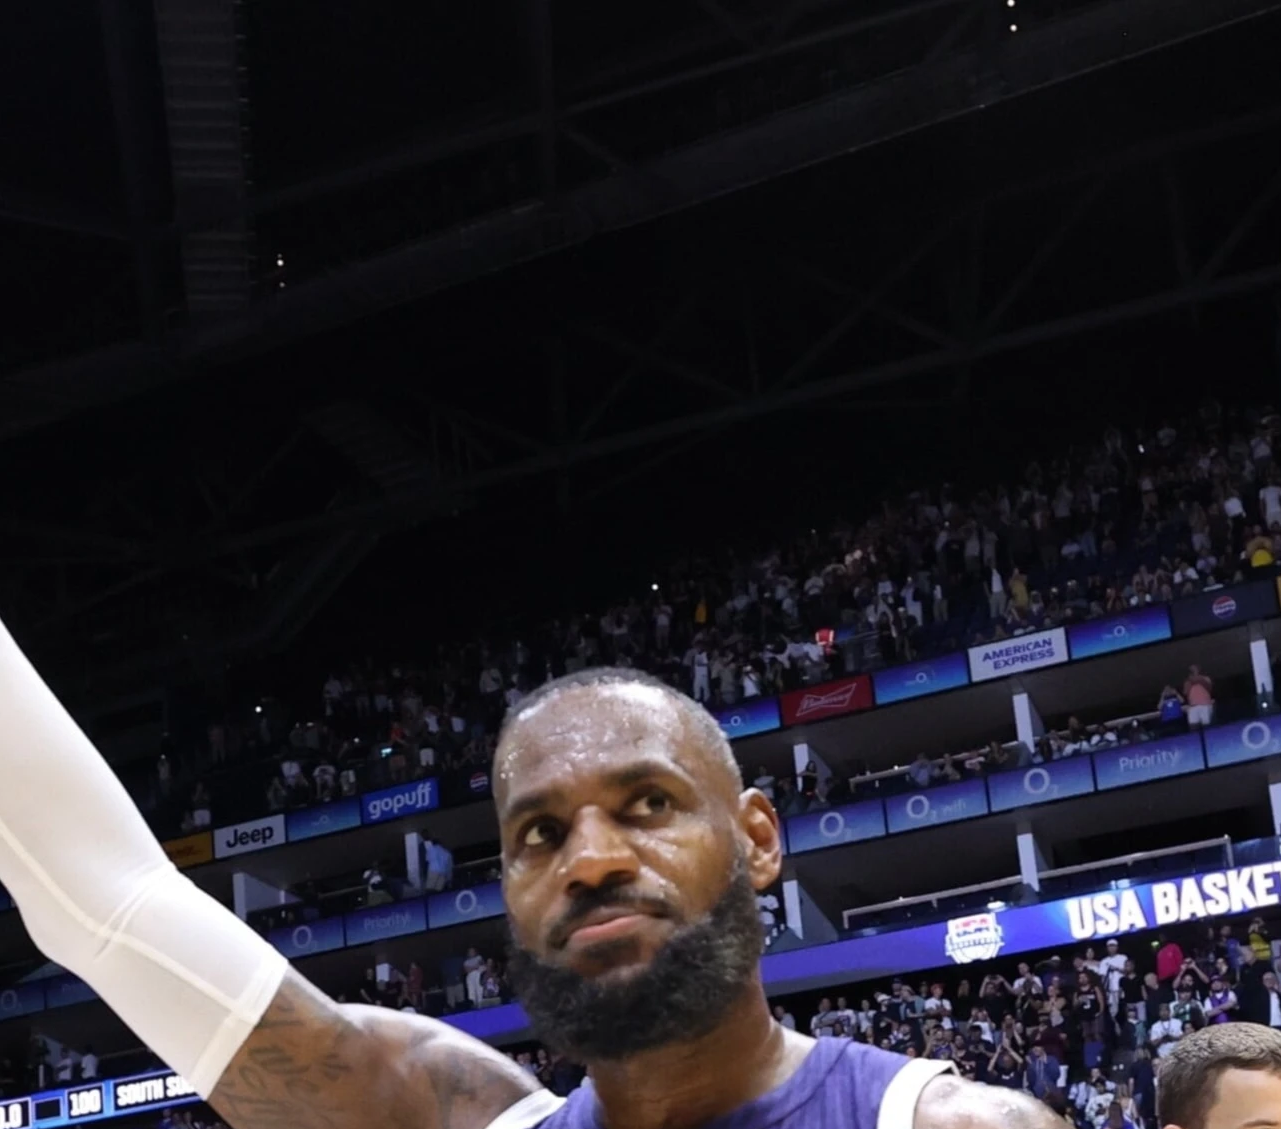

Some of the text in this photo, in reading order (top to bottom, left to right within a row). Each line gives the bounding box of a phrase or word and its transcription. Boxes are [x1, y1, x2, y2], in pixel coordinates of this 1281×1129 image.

[981, 637, 1053, 663] AMERICAN
[992, 648, 1055, 671] EXPRESS
[1118, 748, 1180, 774] Priority
[367, 782, 432, 820] gopuff
[225, 824, 275, 849] Jeep
[1065, 890, 1149, 940] USA
[69, 1088, 102, 1117] 100
[116, 1077, 165, 1107] SOUTH
